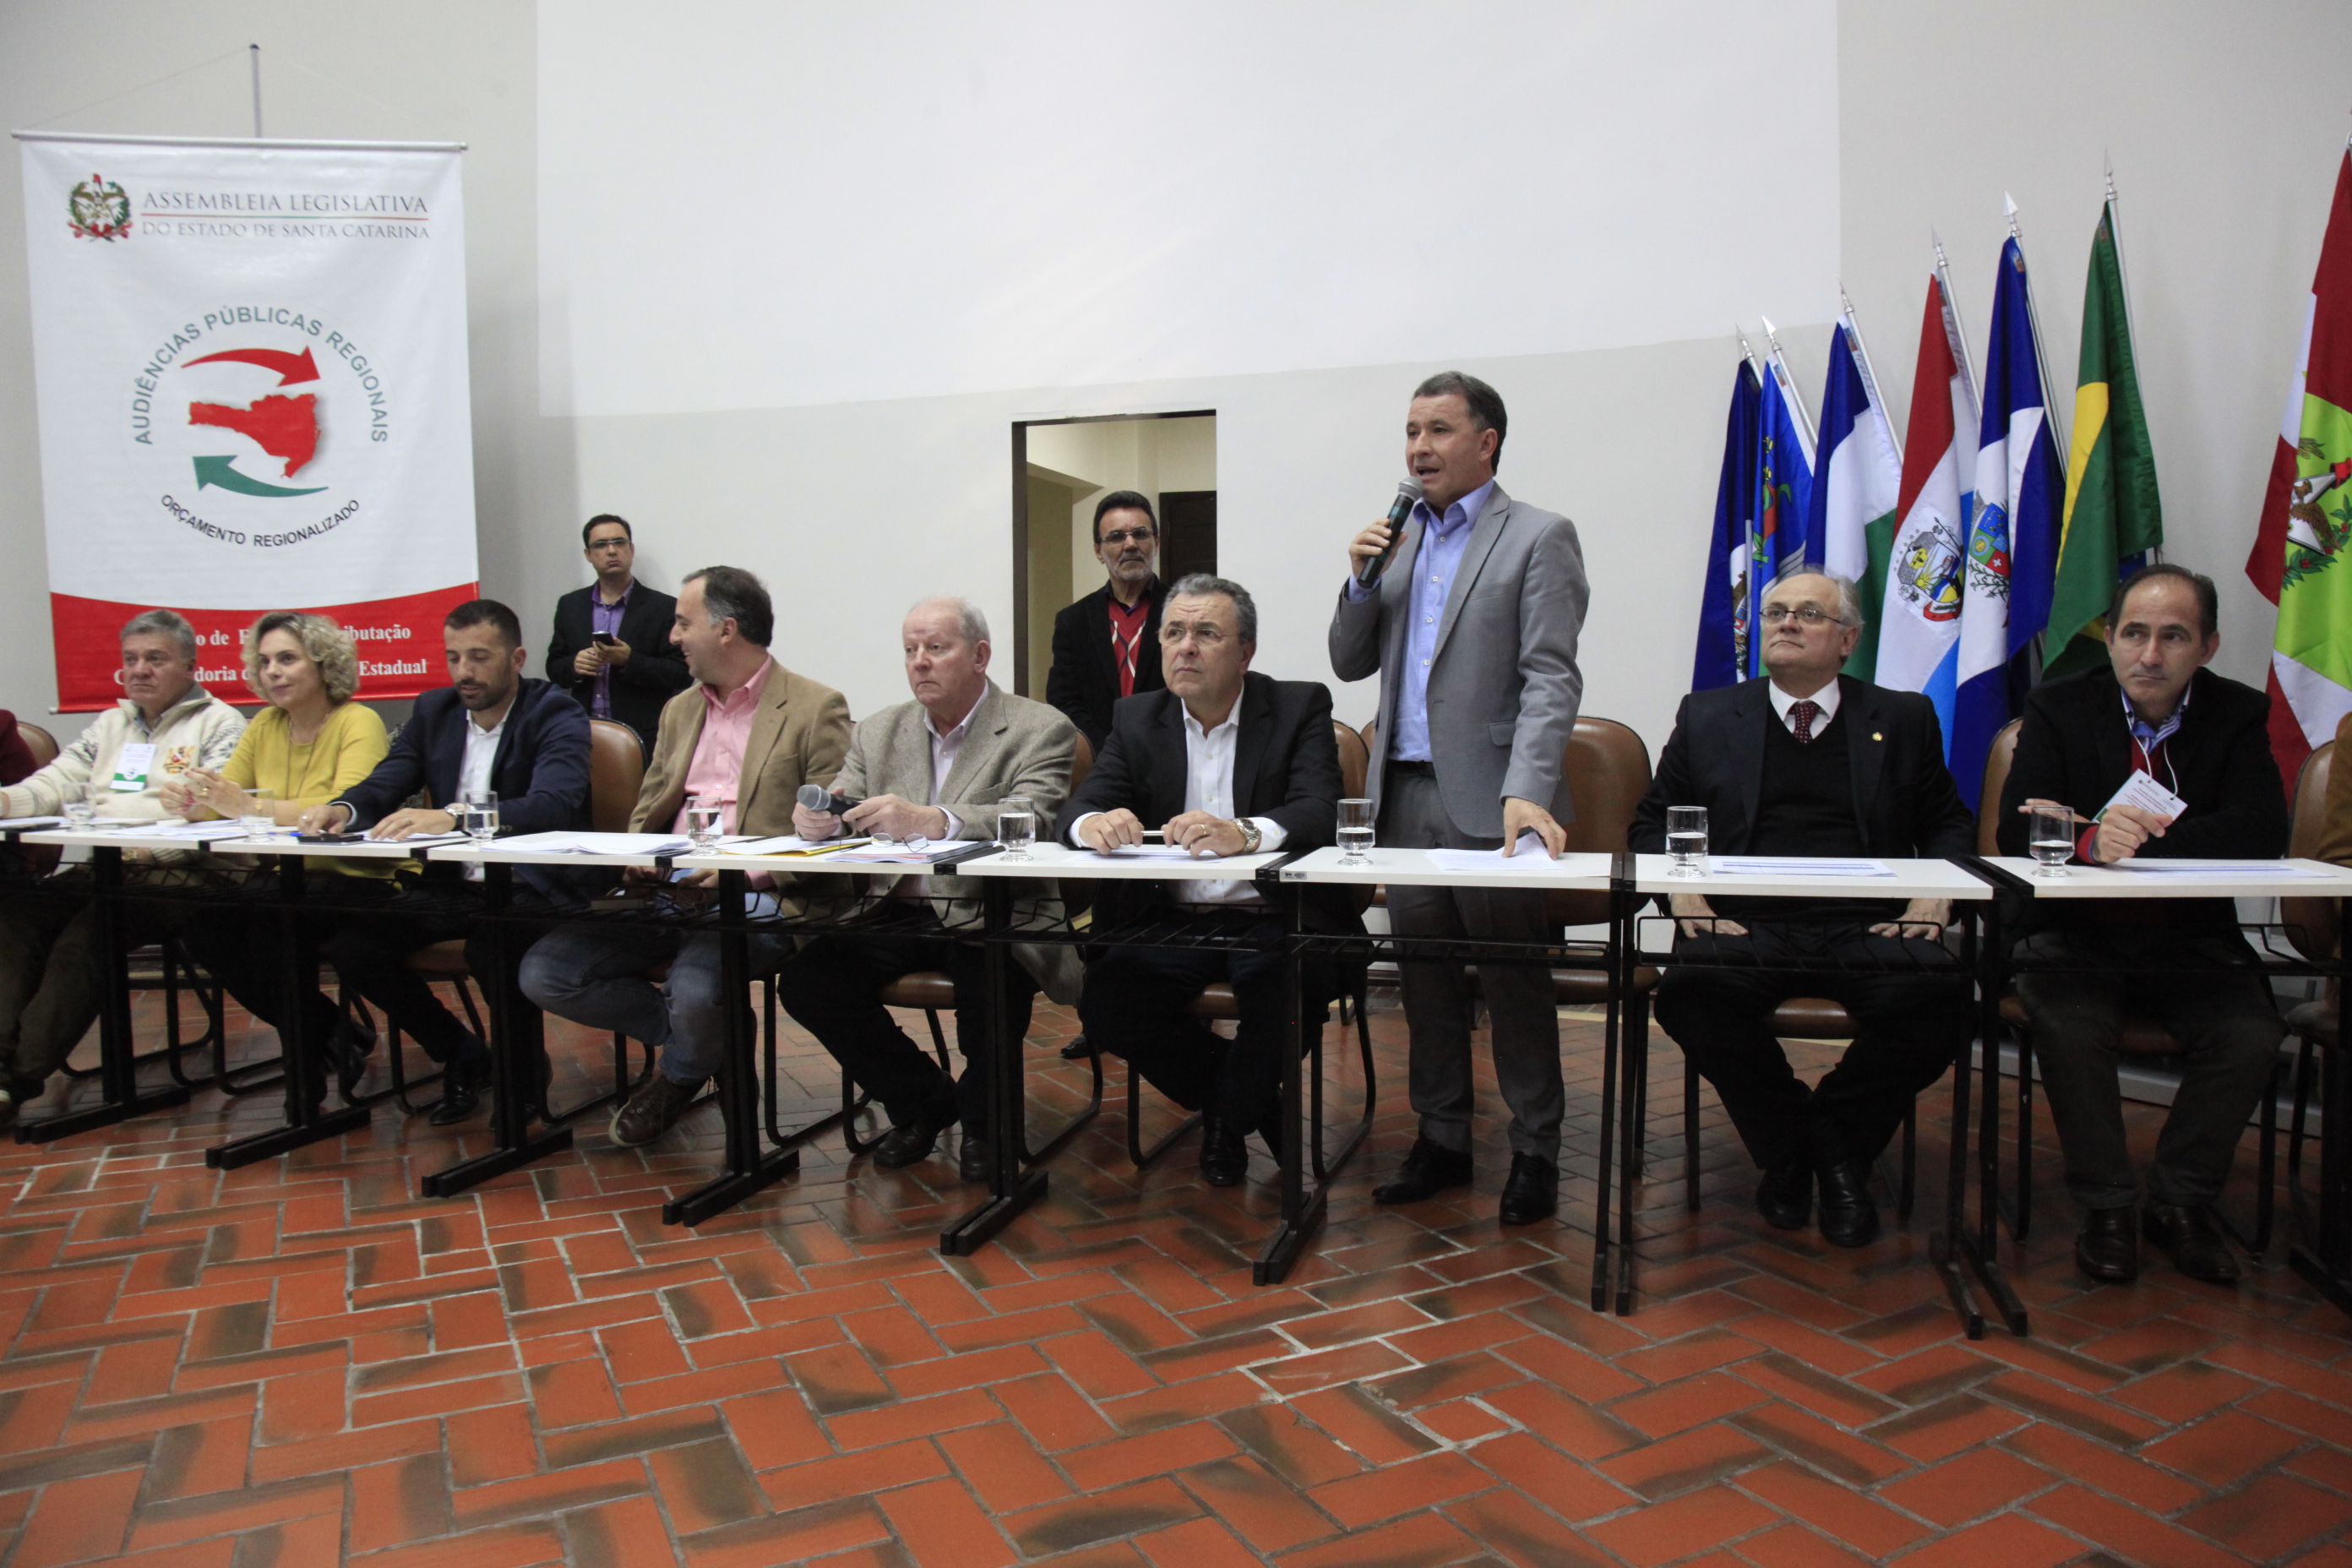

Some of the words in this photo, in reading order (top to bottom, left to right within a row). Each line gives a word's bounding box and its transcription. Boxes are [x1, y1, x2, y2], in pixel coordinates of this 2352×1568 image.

[143, 192, 282, 210] ASSEMBLEIA
[290, 194, 428, 212] LEGISLATIVA
[142, 221, 171, 236] DO
[178, 222, 248, 237] ESTADO
[254, 223, 276, 237] DE
[282, 224, 338, 237] SANTA
[342, 224, 430, 238] CATARINA
[132, 323, 201, 445] AUDIÊNCIAS
[204, 305, 324, 337] PÚBLICAS
[325, 330, 388, 443] REGIONAIS
[161, 494, 246, 545] ORÇAMENTO
[253, 499, 360, 547] REGIONALIZADO
[210, 629, 230, 645] de
[344, 623, 411, 643] butação
[358, 658, 427, 676] Estadual
